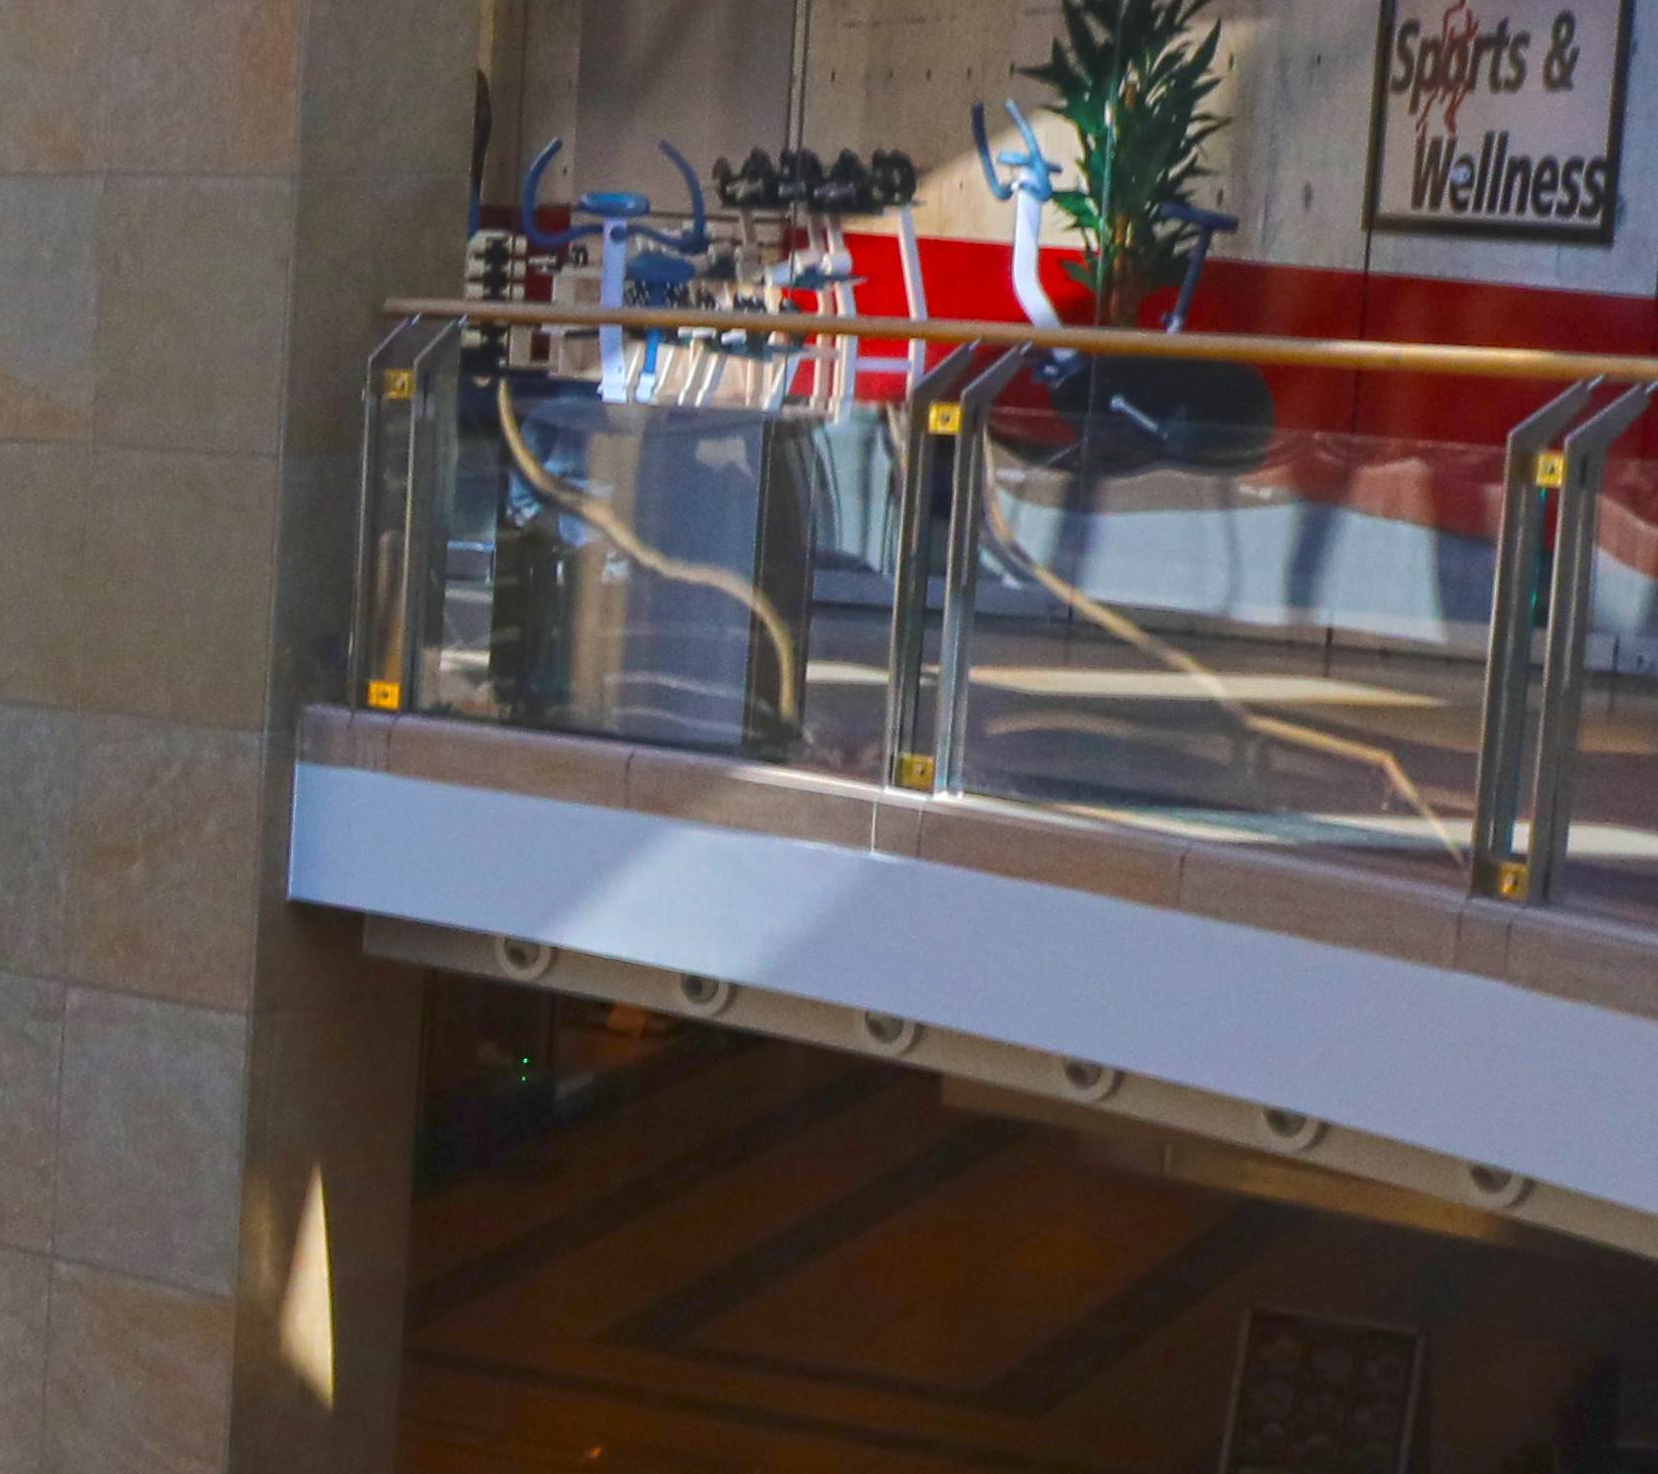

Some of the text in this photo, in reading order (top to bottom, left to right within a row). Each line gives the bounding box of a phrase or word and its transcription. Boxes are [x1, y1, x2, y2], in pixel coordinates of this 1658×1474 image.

[1391, 8, 1580, 115] Sports &
[1410, 130, 1609, 219] Wellness
